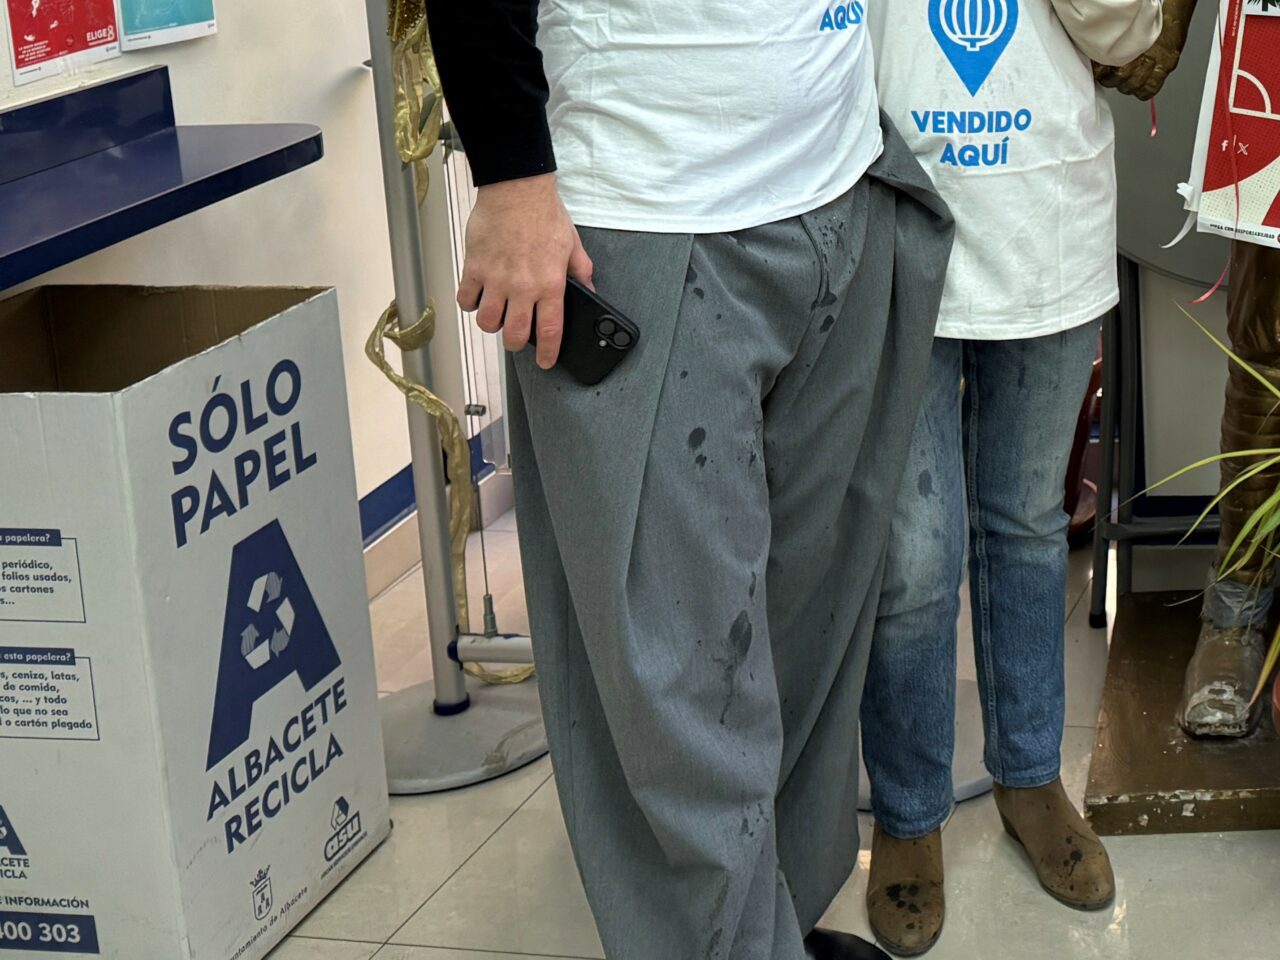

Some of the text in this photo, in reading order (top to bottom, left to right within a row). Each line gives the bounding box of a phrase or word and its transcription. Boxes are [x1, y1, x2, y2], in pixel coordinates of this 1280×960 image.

[910, 108, 1032, 134] VENDIDO
[939, 136, 1009, 166] AQUÍ
[168, 358, 302, 476] SÓLO
[170, 421, 318, 548] PAPEL
[5, 534, 50, 544] papelera?
[2, 560, 53, 571] periódico,
[2, 572, 72, 583] folios usados,
[10, 585, 54, 594] cartones
[4, 652, 71, 663] esta papelera?
[12, 671, 48, 682] ceniza,
[51, 670, 80, 682] latas,
[3, 682, 60, 693] de comida,
[35, 697, 41, 706] y
[44, 696, 68, 704] todo
[13, 708, 32, 718] que
[35, 708, 48, 716] no
[51, 708, 68, 716] sea
[14, 718, 48, 728] cartón
[52, 720, 92, 730] plegado
[206, 676, 347, 822] ALBACETE
[224, 732, 344, 854] RECICLA
[0, 856, 30, 868] CETE
[5, 896, 90, 909] INFORMACIÓN
[268, 914, 278, 928] de
[38, 922, 81, 944] 303
